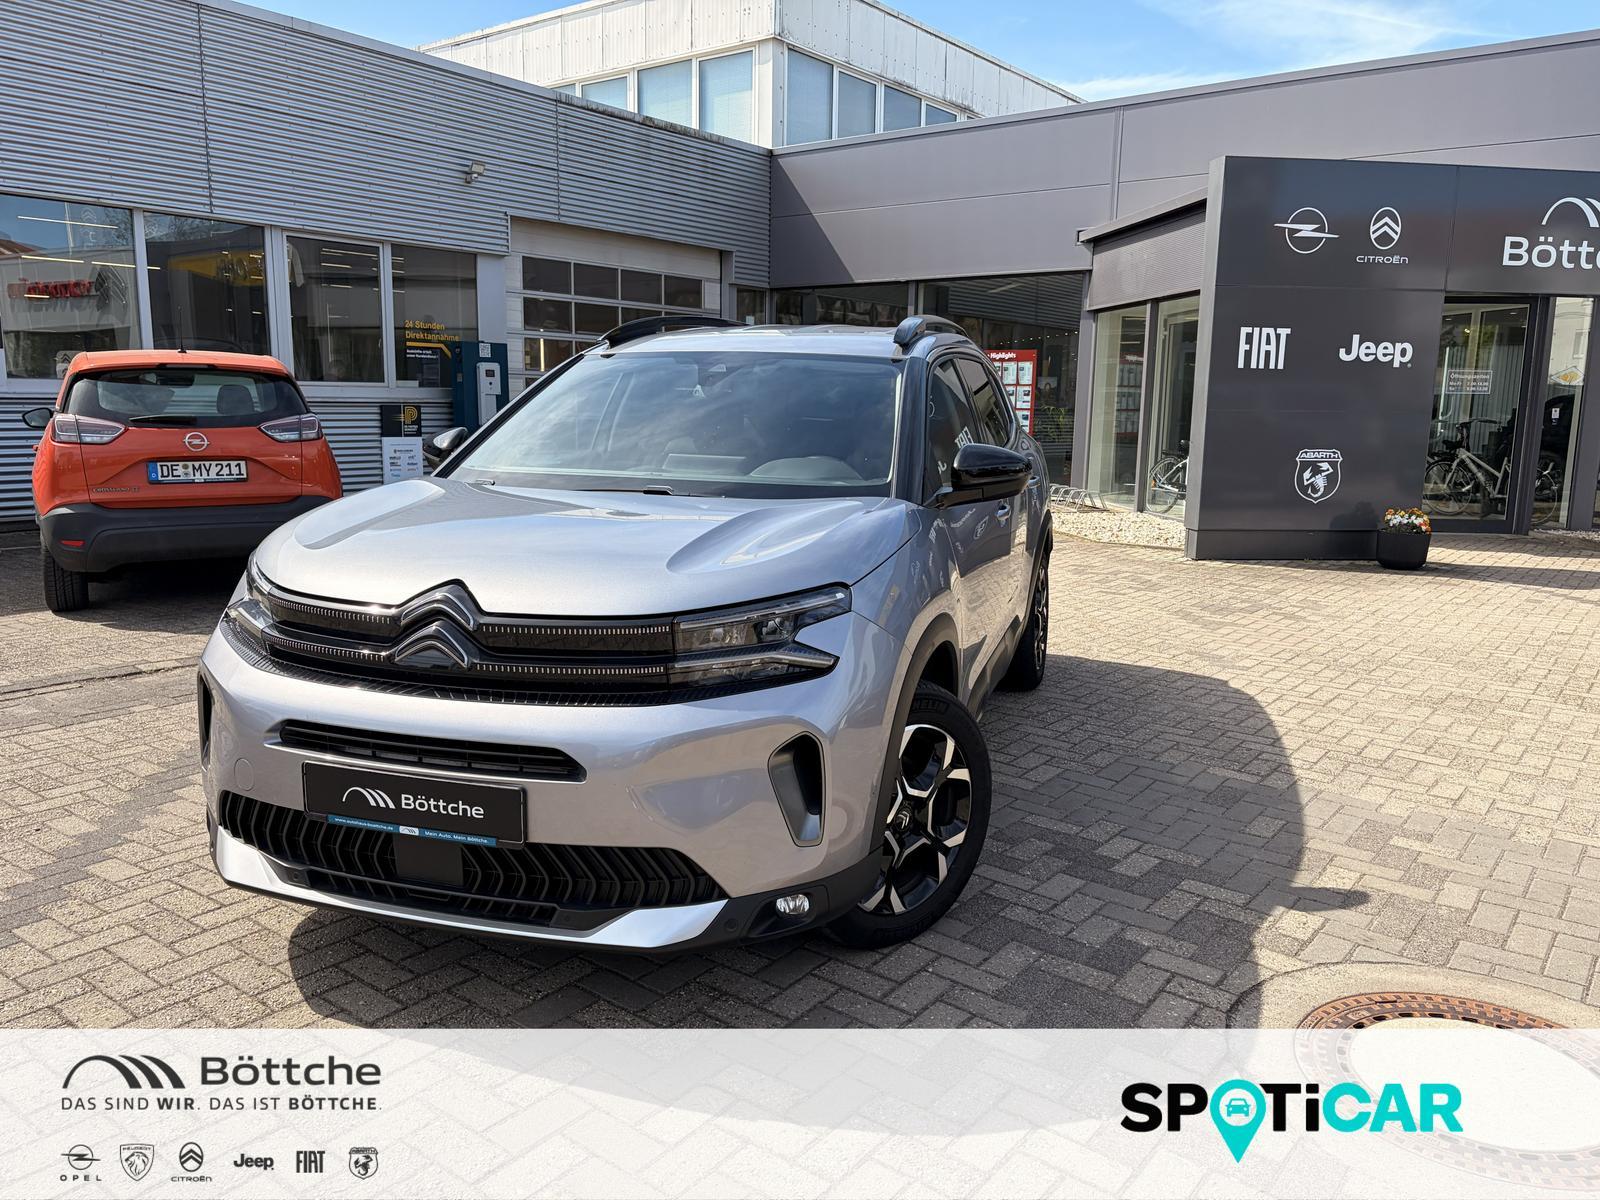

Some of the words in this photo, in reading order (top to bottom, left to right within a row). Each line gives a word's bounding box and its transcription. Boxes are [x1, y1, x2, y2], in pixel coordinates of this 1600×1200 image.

[1502, 236, 1600, 269] Bött
[405, 320, 413, 328] 24
[415, 321, 445, 330] Stunden
[405, 331, 461, 341] Direktannahme
[1237, 326, 1292, 369] FIAT
[1339, 334, 1413, 368] Jeep
[990, 352, 1017, 360] Highlights
[1300, 451, 1339, 459] ABARTH
[160, 464, 181, 478] DE
[192, 463, 213, 477] MY
[215, 463, 245, 477] 211
[401, 793, 485, 819] Böttche
